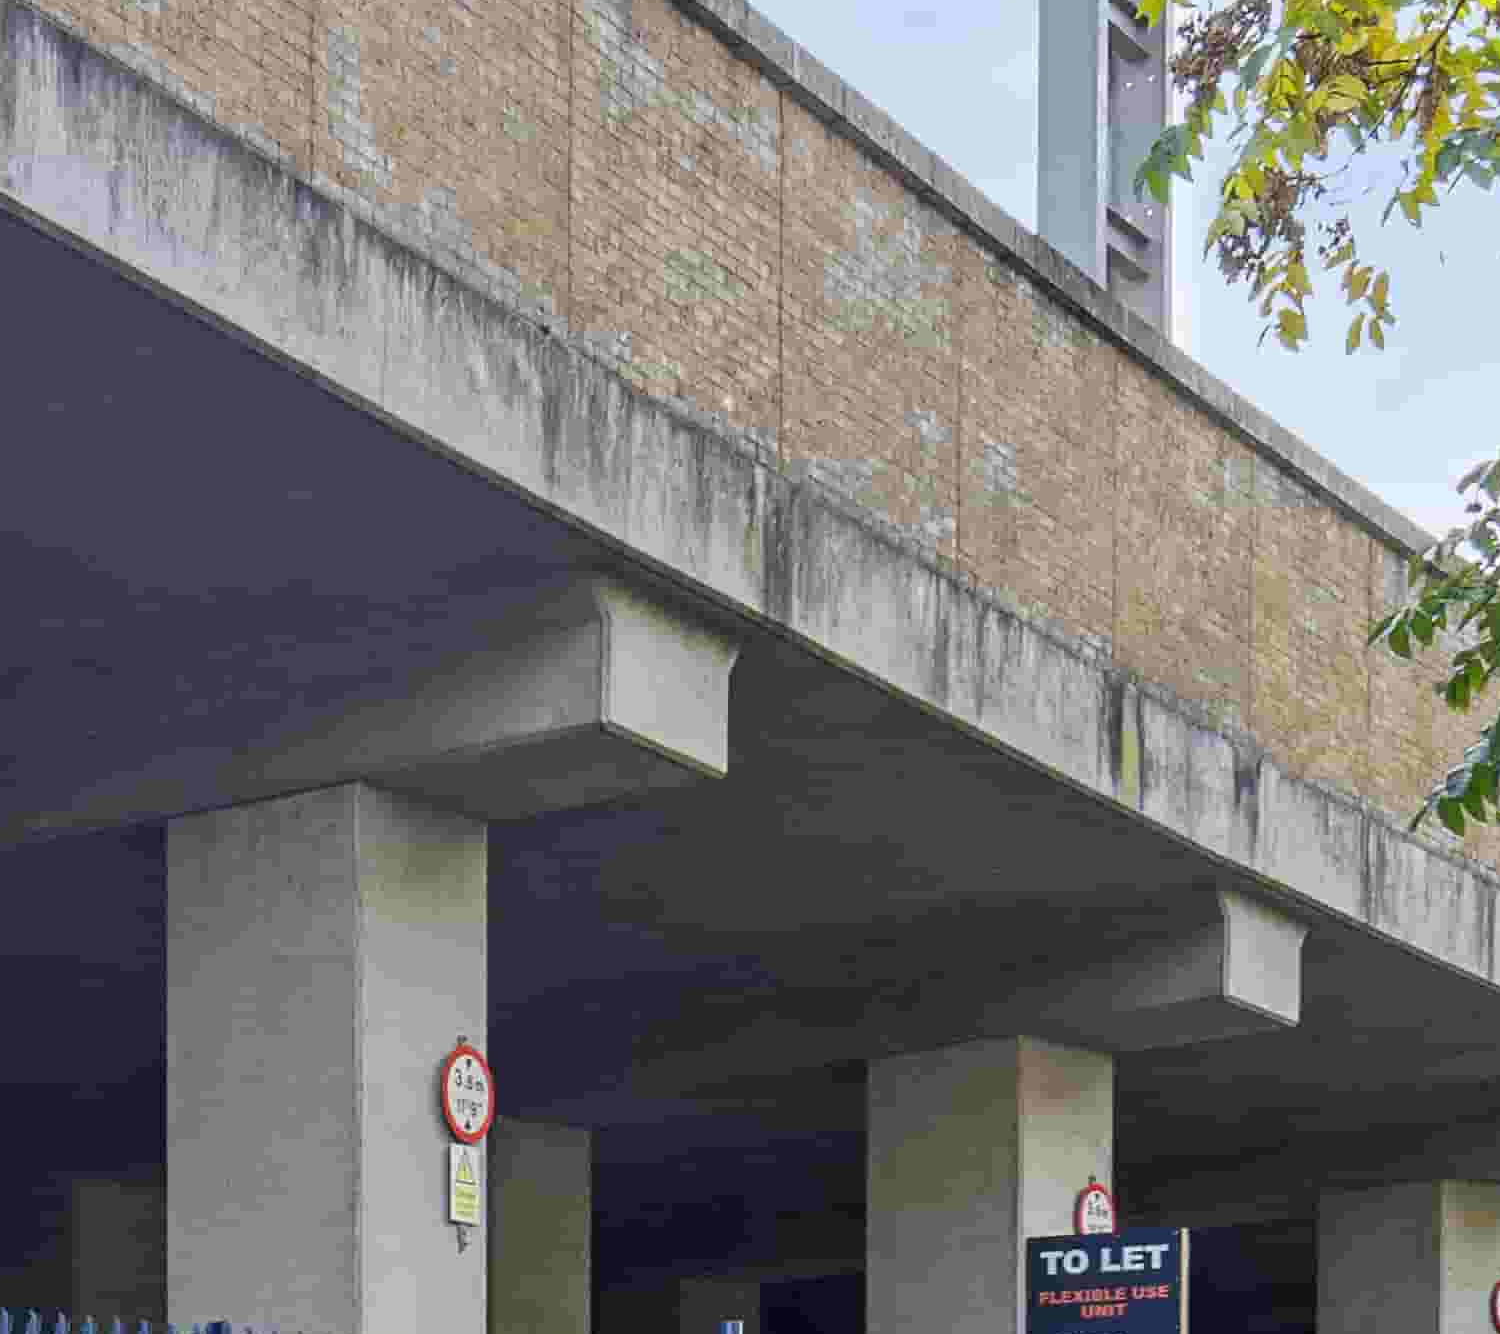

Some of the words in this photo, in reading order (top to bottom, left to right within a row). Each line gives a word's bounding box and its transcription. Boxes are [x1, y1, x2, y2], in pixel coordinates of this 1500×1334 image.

[1039, 1249, 1090, 1275] TO
[1099, 1244, 1170, 1273] LET
[1039, 1287, 1128, 1306] FLEXIBLE
[1131, 1283, 1170, 1300] USE
[1080, 1305, 1127, 1319] UNIT
